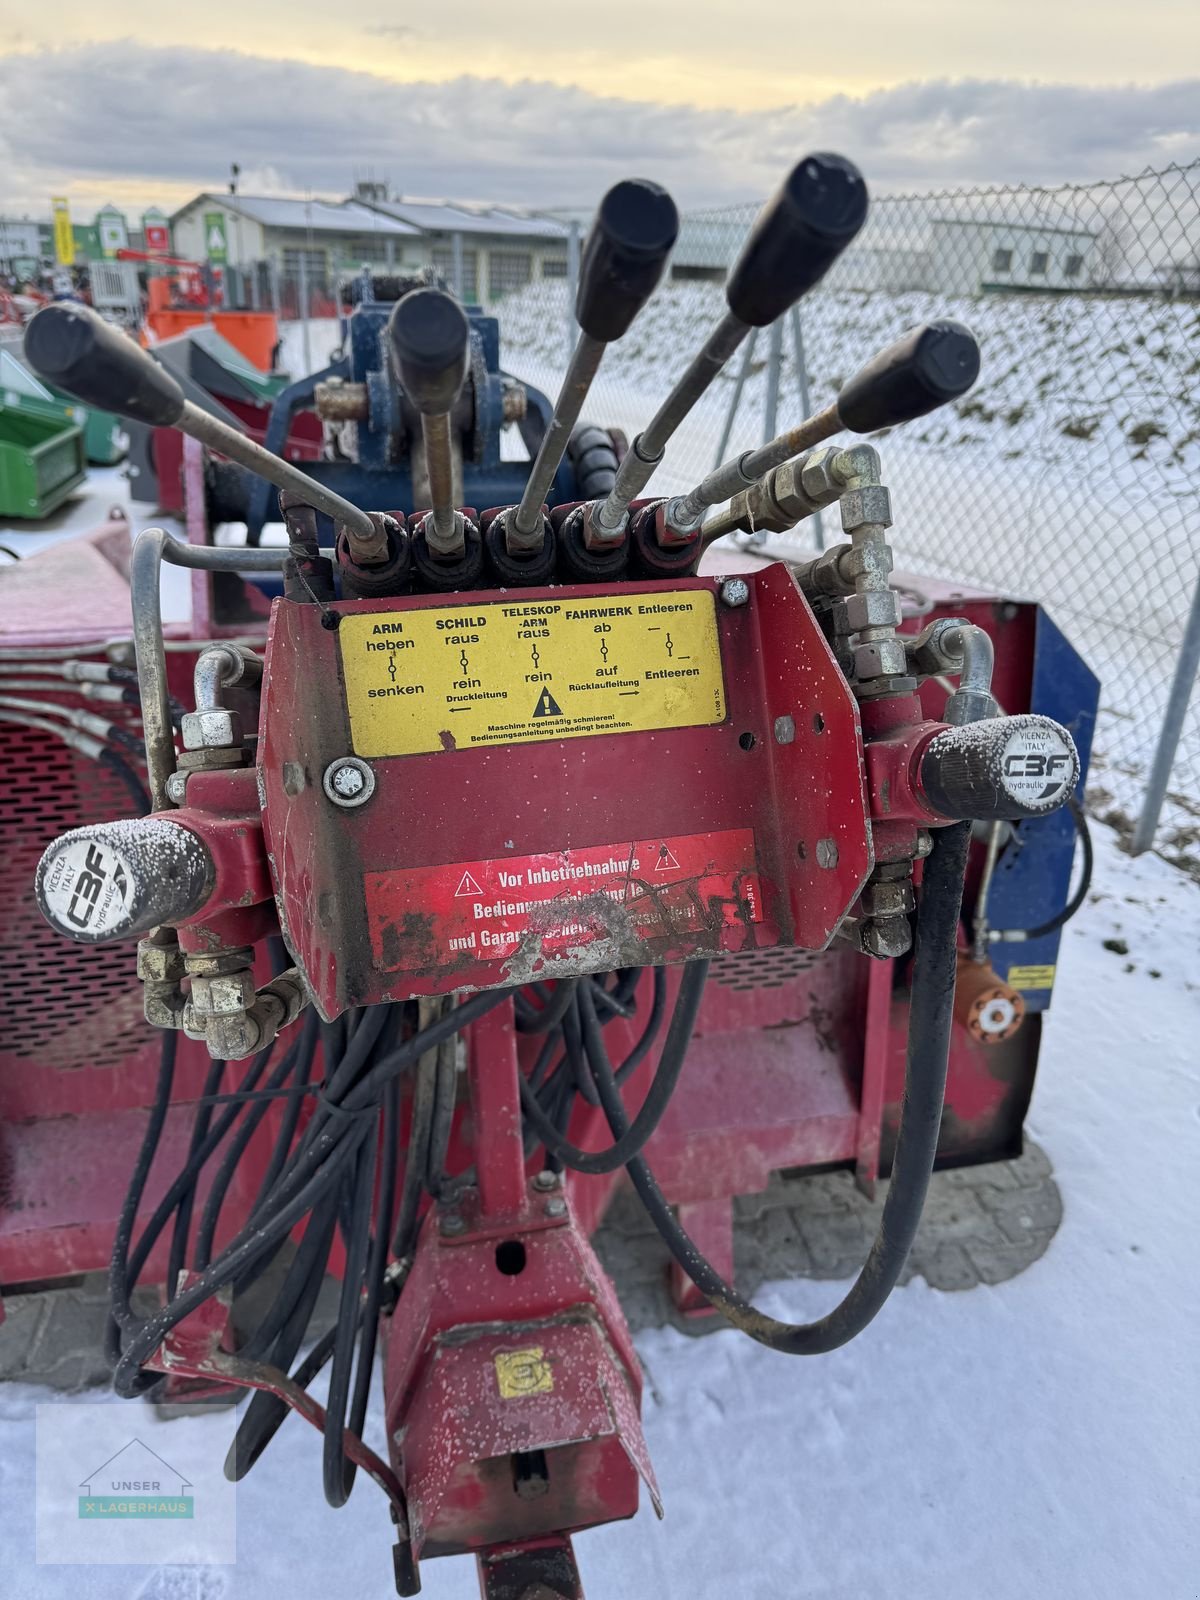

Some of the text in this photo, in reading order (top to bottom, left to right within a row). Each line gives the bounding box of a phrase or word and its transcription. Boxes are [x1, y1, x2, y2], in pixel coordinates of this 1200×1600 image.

[502, 605, 561, 617] TELESKOP
[565, 607, 633, 620] FAHRWERK
[638, 603, 693, 615] Entleeren
[372, 623, 403, 635] ARM
[436, 616, 487, 630] SCHILD
[519, 618, 548, 628] -ARM
[593, 623, 612, 633] ab
[445, 633, 480, 645] raus
[517, 629, 551, 639] raus
[366, 639, 415, 652] heben
[524, 671, 553, 683] rein
[595, 665, 618, 677] auf
[645, 668, 700, 680] Entleeren
[453, 677, 481, 690] rein
[569, 679, 640, 692] Rücklaufleitung
[367, 684, 425, 698] senken
[446, 690, 508, 703] Druckleitung
[487, 714, 615, 732] Maschine regelmäßig schmieren!
[470, 721, 633, 742] Bedienungsanleitung unbedingt beachten.
[1020, 731, 1052, 740] VICENZA
[1025, 742, 1046, 751] ITALY
[1008, 780, 1044, 791] hydraulic
[47, 856, 68, 893] VICENZA
[60, 866, 77, 892] ITALY
[498, 857, 640, 888] Vor Inbetriebnahme
[93, 884, 117, 930] hydraulic
[448, 932, 477, 951] und
